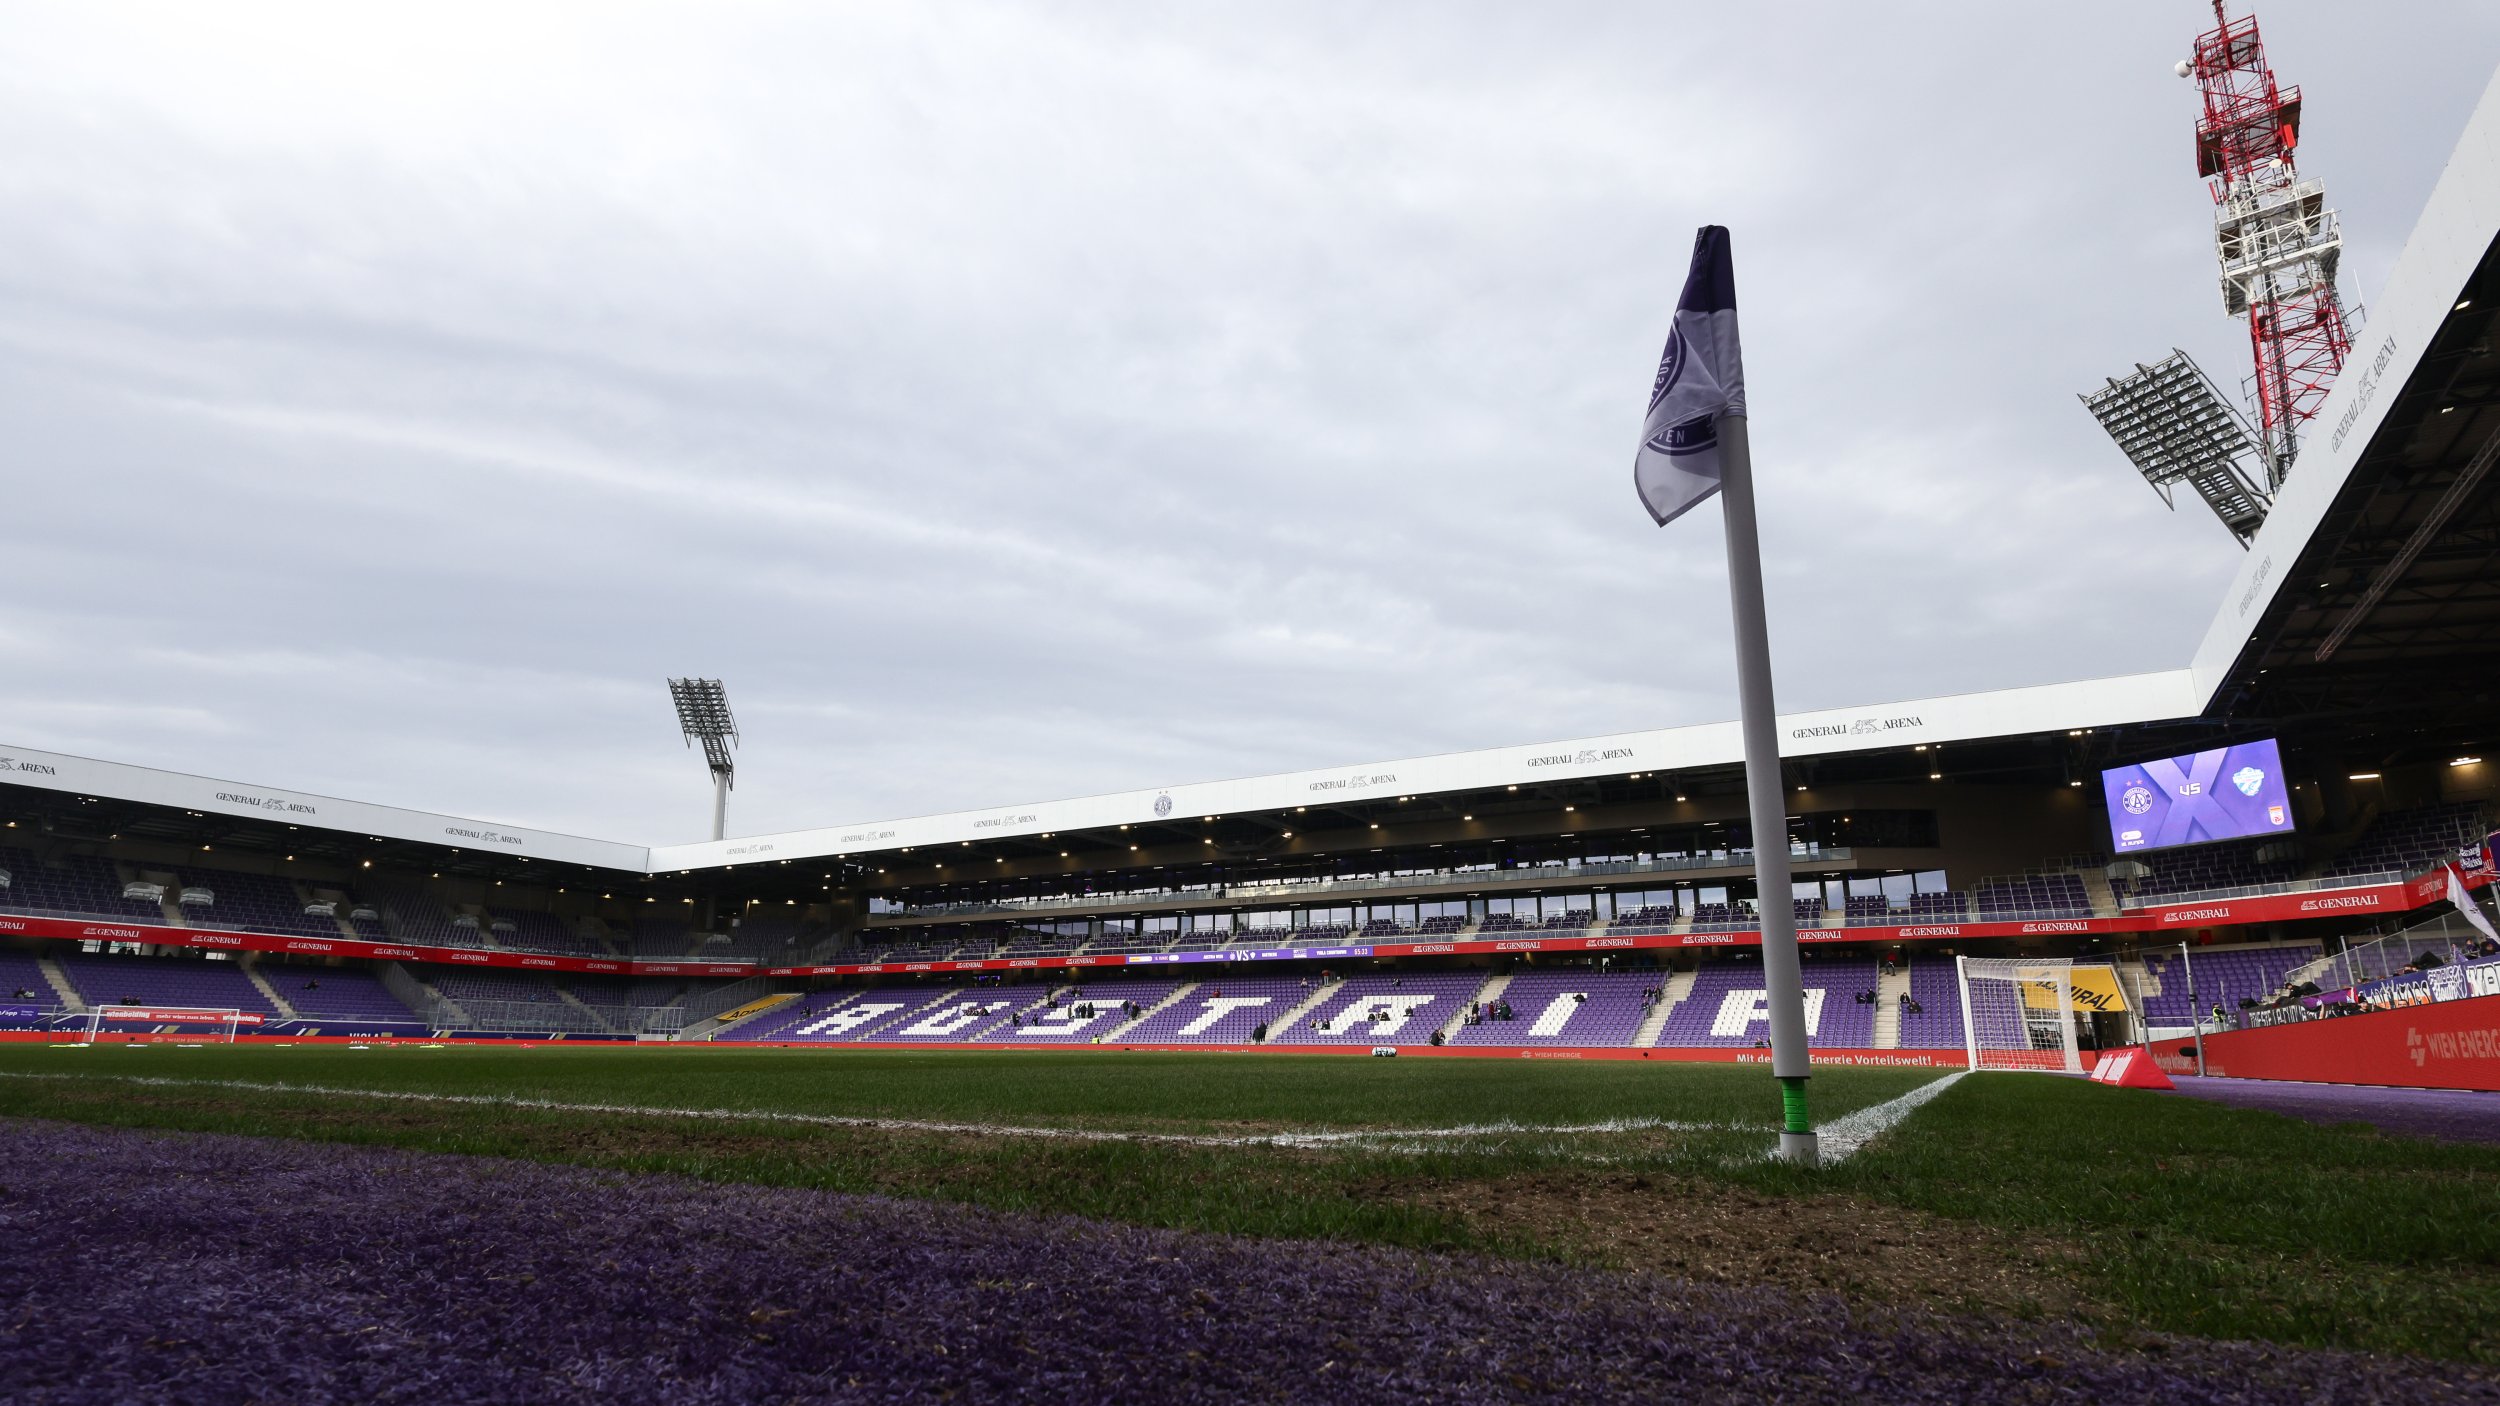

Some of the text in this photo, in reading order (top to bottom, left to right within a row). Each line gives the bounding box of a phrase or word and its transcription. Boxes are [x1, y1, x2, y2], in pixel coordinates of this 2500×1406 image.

[2373, 334, 2397, 382] ARENA
[1792, 716, 1923, 739] GENERALI ARENA
[1527, 748, 1633, 768] GENERALI ARENA
[17, 762, 56, 775] ARENA
[1309, 774, 1397, 792] GENERALI ARENA
[215, 792, 316, 815] GENERALI ARENA
[973, 815, 1037, 829] GENERALI ARENA
[445, 827, 522, 845] GENERALI ARENA
[840, 831, 896, 843] GENERALI ARENA
[2318, 895, 2379, 909] GENERALI
[2179, 908, 2230, 920] GENERALI
[97, 927, 140, 938] GENERALI
[1913, 927, 1960, 937] GENERALI
[2037, 921, 2088, 933] GENERALI
[203, 936, 242, 945] GENERALI
[1694, 934, 1734, 944] GENERALI
[1799, 930, 1842, 941] GENERALI
[298, 942, 332, 951] GENERALI
[1422, 944, 1455, 953] GENERALI
[1506, 941, 1541, 950] GENERALI
[1597, 938, 1634, 947] GENERALI
[460, 954, 489, 962] GENERALI
[1072, 957, 1096, 965] GENERALI
[1236, 950, 1249, 962] VS
[2425, 1031, 2460, 1058] WIEN
[1736, 1053, 1754, 1063] Mit
[1809, 1054, 1853, 1065] Energie
[1854, 1055, 1932, 1066] Vorteilswelt!
